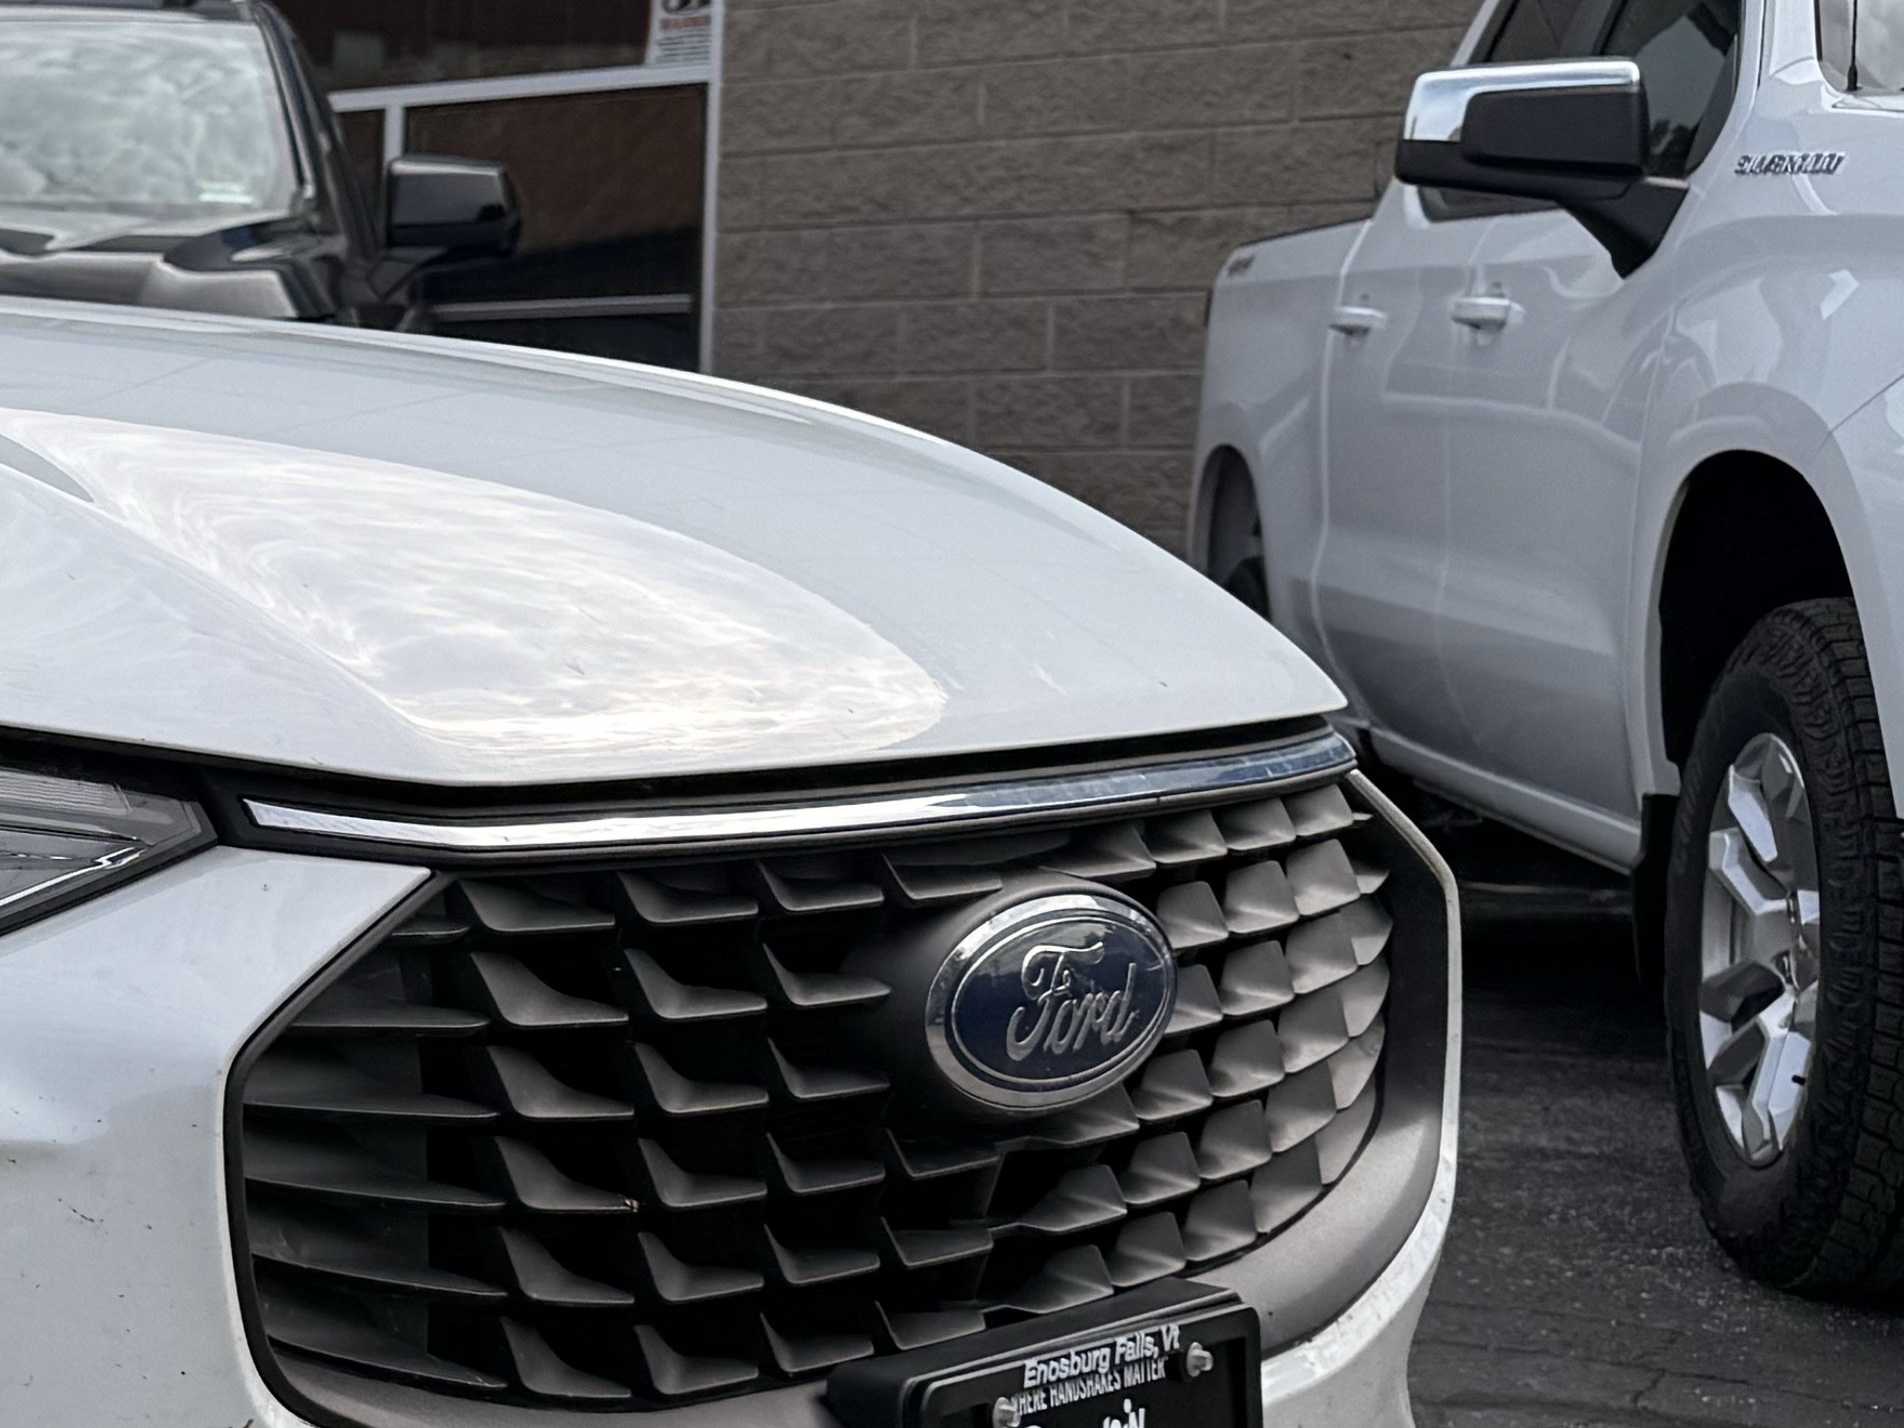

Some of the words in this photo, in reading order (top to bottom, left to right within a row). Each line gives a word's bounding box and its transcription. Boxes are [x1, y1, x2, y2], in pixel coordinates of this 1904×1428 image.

[1006, 941, 1140, 1062] Ford
[1023, 1346, 1111, 1389] Enosburg
[1114, 1330, 1159, 1365] Falls,
[1049, 1369, 1122, 1408] HANDSHAKES
